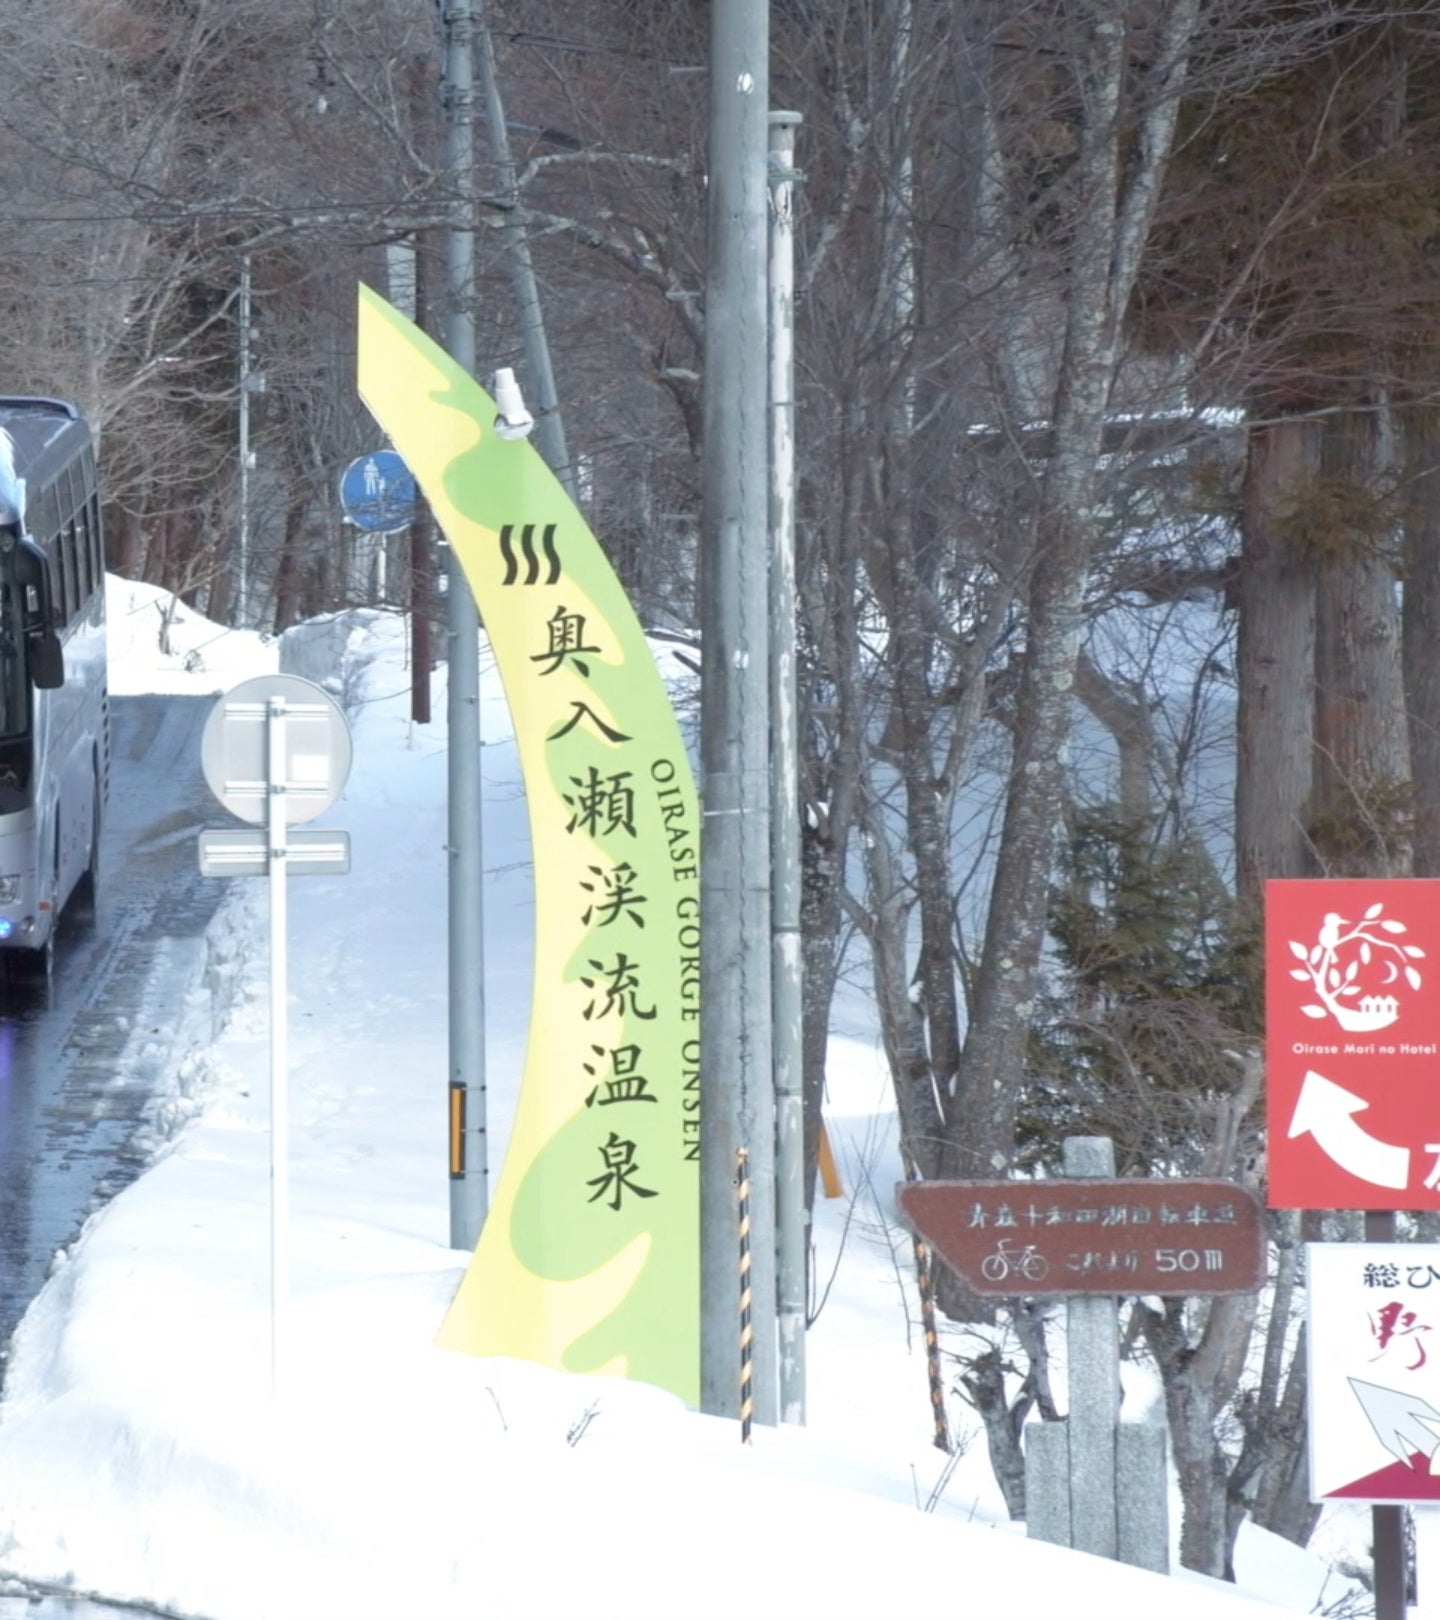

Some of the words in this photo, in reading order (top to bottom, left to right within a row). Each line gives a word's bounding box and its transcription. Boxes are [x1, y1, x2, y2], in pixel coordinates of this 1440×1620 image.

[650, 758, 699, 883] OIRASE
[529, 605, 659, 1212] 奥入瀬渓流温泉
[676, 896, 701, 1022] GORGE
[681, 1039, 701, 1162] ONSEN
[1292, 1042, 1339, 1055] Oirase
[1343, 1043, 1376, 1055] Mori
[1379, 1044, 1396, 1055] no
[1400, 1043, 1437, 1055] Hotel
